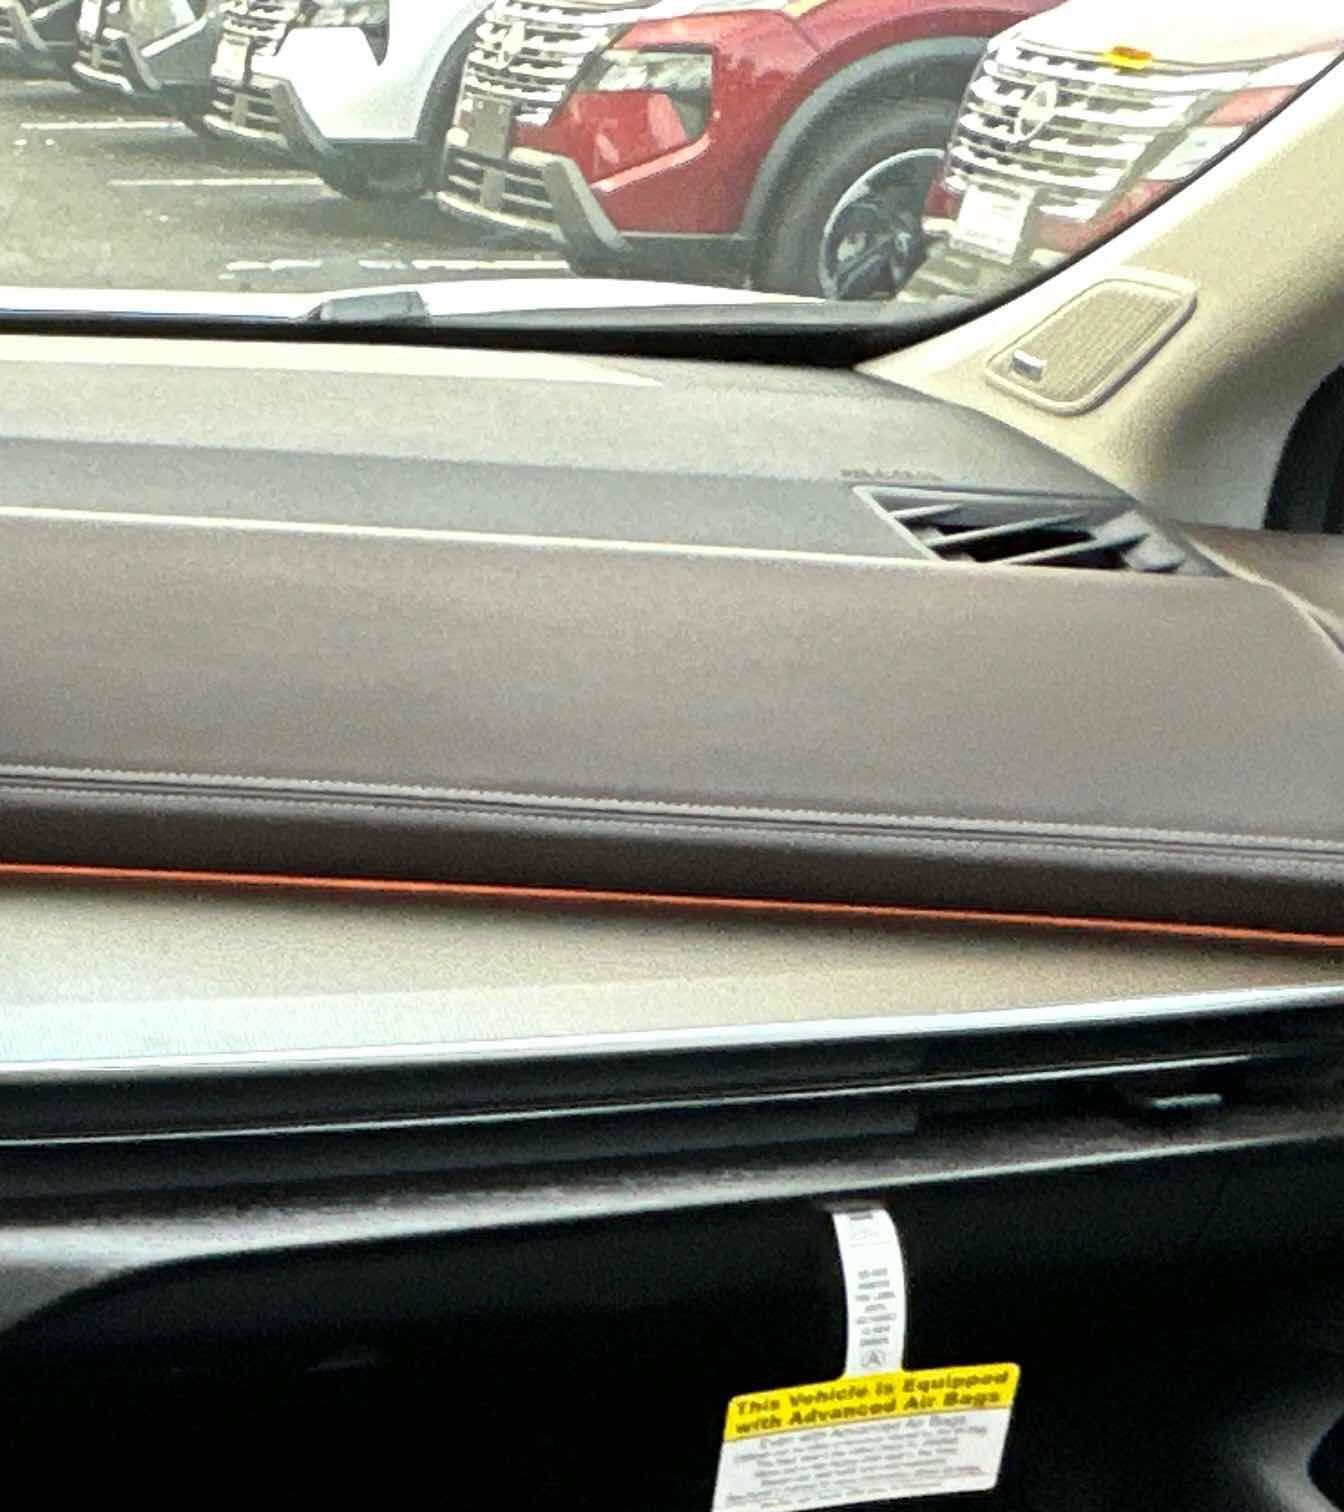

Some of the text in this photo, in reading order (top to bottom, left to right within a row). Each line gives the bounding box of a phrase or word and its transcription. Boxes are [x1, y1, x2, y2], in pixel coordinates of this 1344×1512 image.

[736, 1369, 1010, 1416] This Vehicle is Equipped
[736, 1389, 1000, 1434] with Advanced Air Bags
